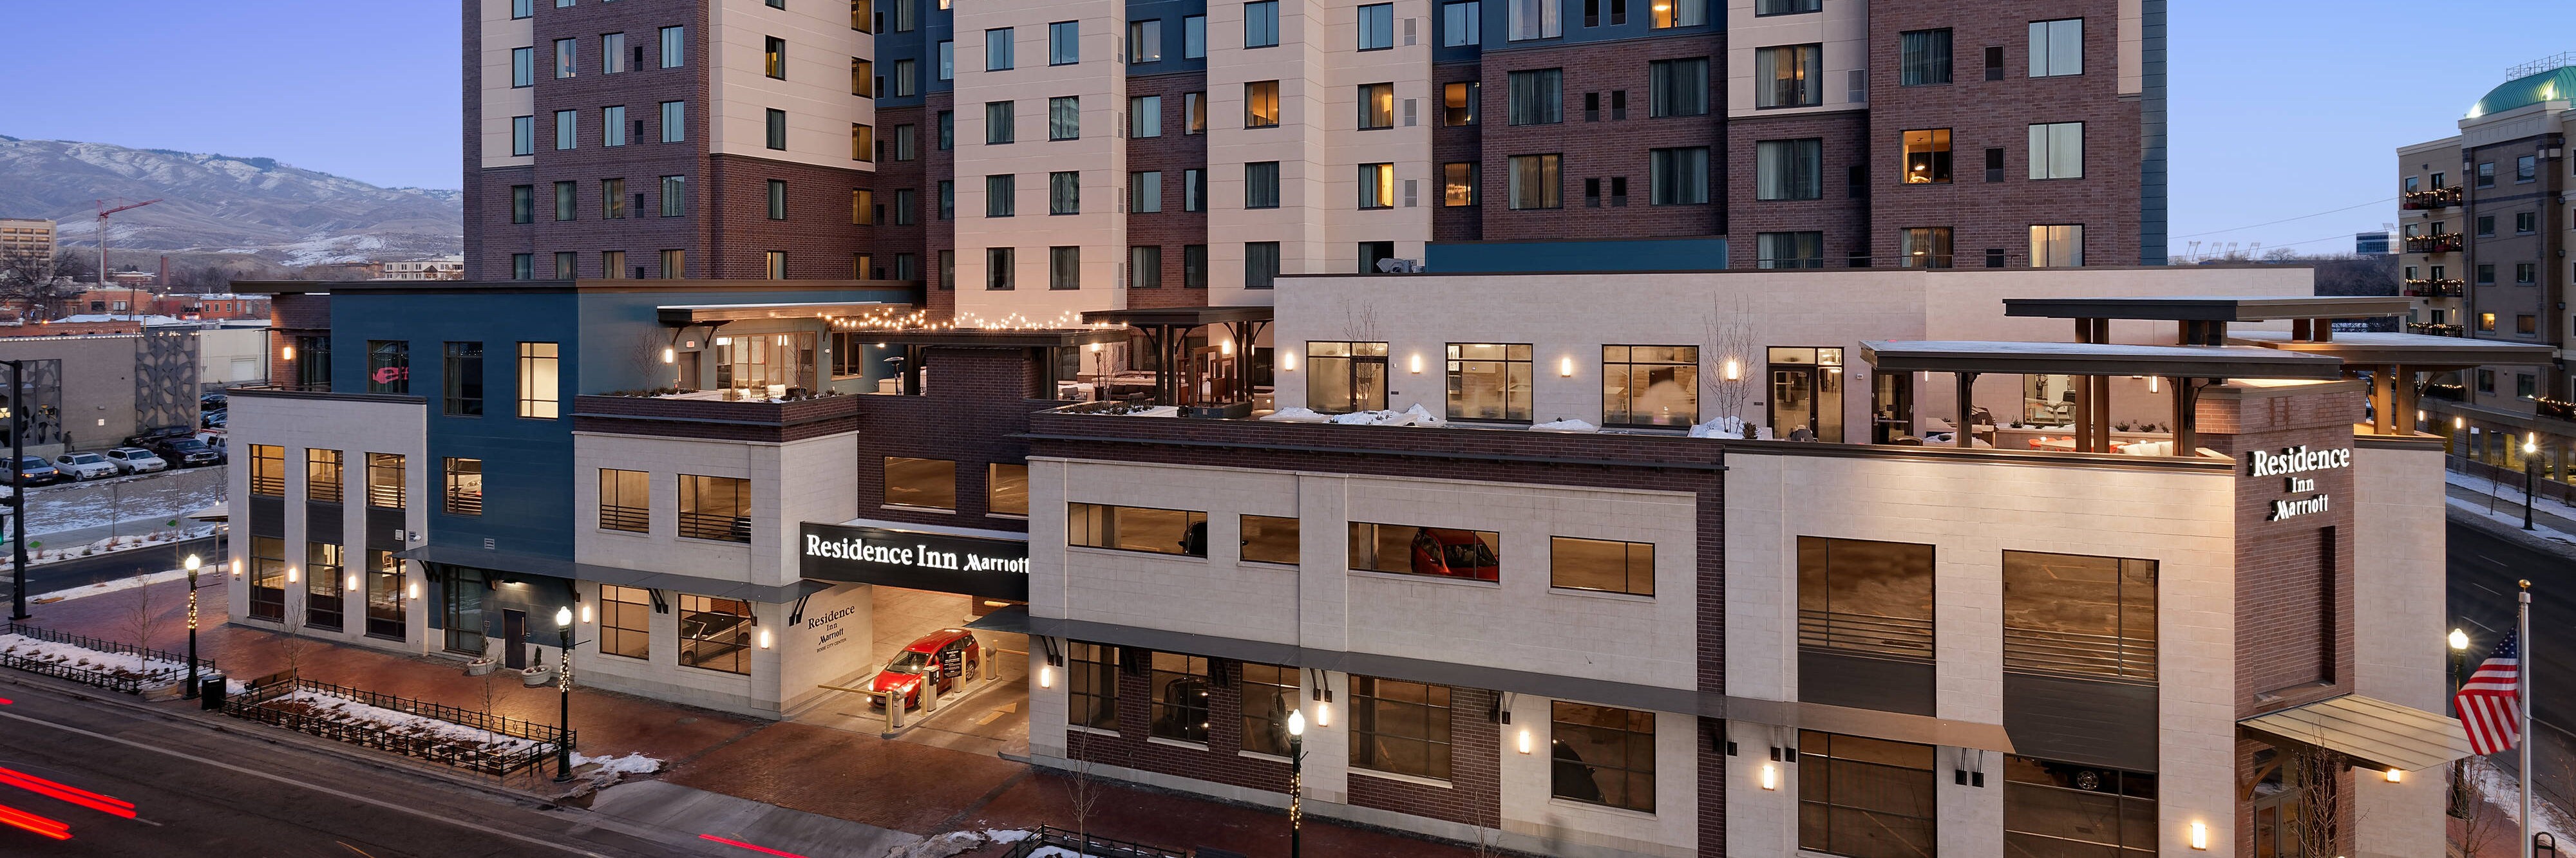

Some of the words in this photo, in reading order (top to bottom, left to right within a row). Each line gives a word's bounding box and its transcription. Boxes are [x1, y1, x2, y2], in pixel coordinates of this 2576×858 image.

[2253, 445, 2350, 477] Residence
[2291, 477, 2315, 493] Inn
[2273, 494, 2329, 522] Marriott
[806, 534, 913, 565] Residence
[916, 544, 958, 570] Inn
[963, 553, 1029, 574] Marriott
[808, 605, 855, 630] Residence
[826, 622, 838, 631] Inn
[818, 627, 844, 646] Marriott
[834, 638, 847, 646] CENTER
